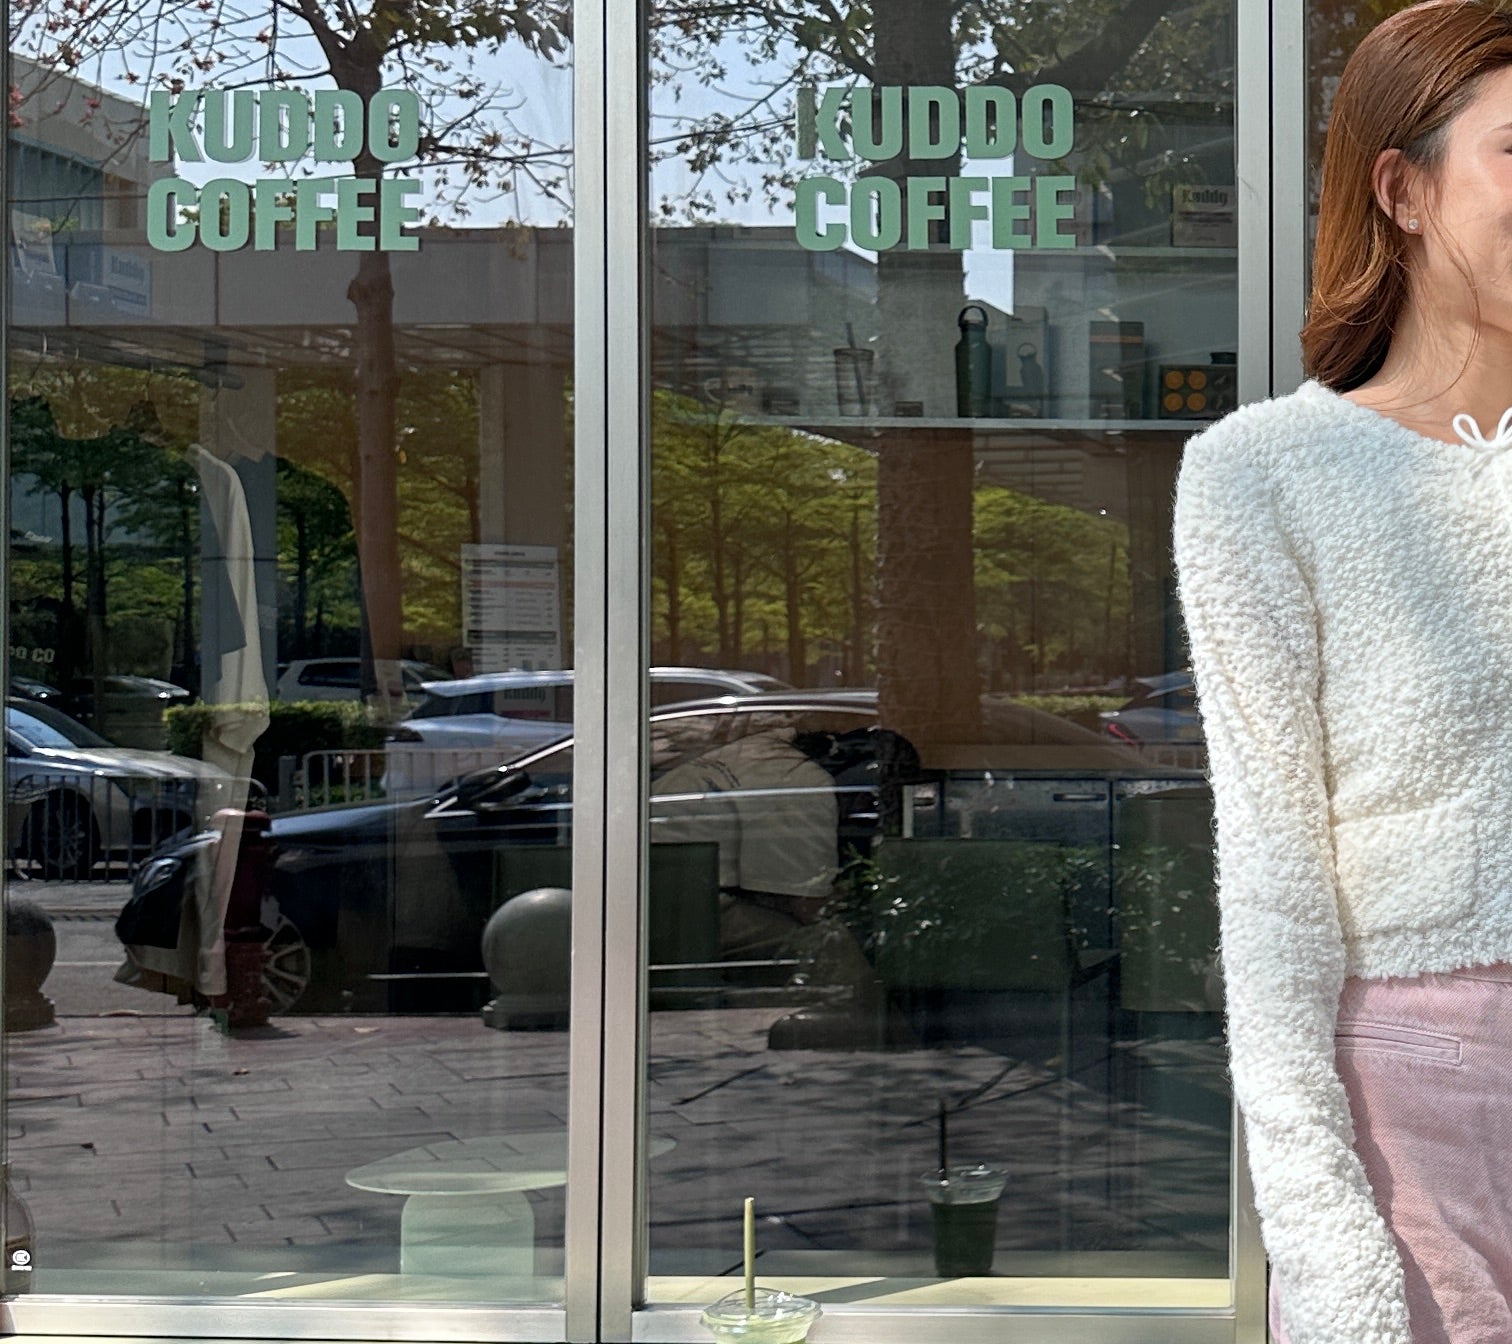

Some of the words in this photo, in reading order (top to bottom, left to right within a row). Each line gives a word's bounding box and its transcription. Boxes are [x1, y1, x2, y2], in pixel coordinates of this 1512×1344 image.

[148, 88, 420, 162] KUDDO
[797, 84, 1074, 160] KUDDO
[146, 177, 421, 252] COFFEE
[796, 175, 1077, 252] COFFEE
